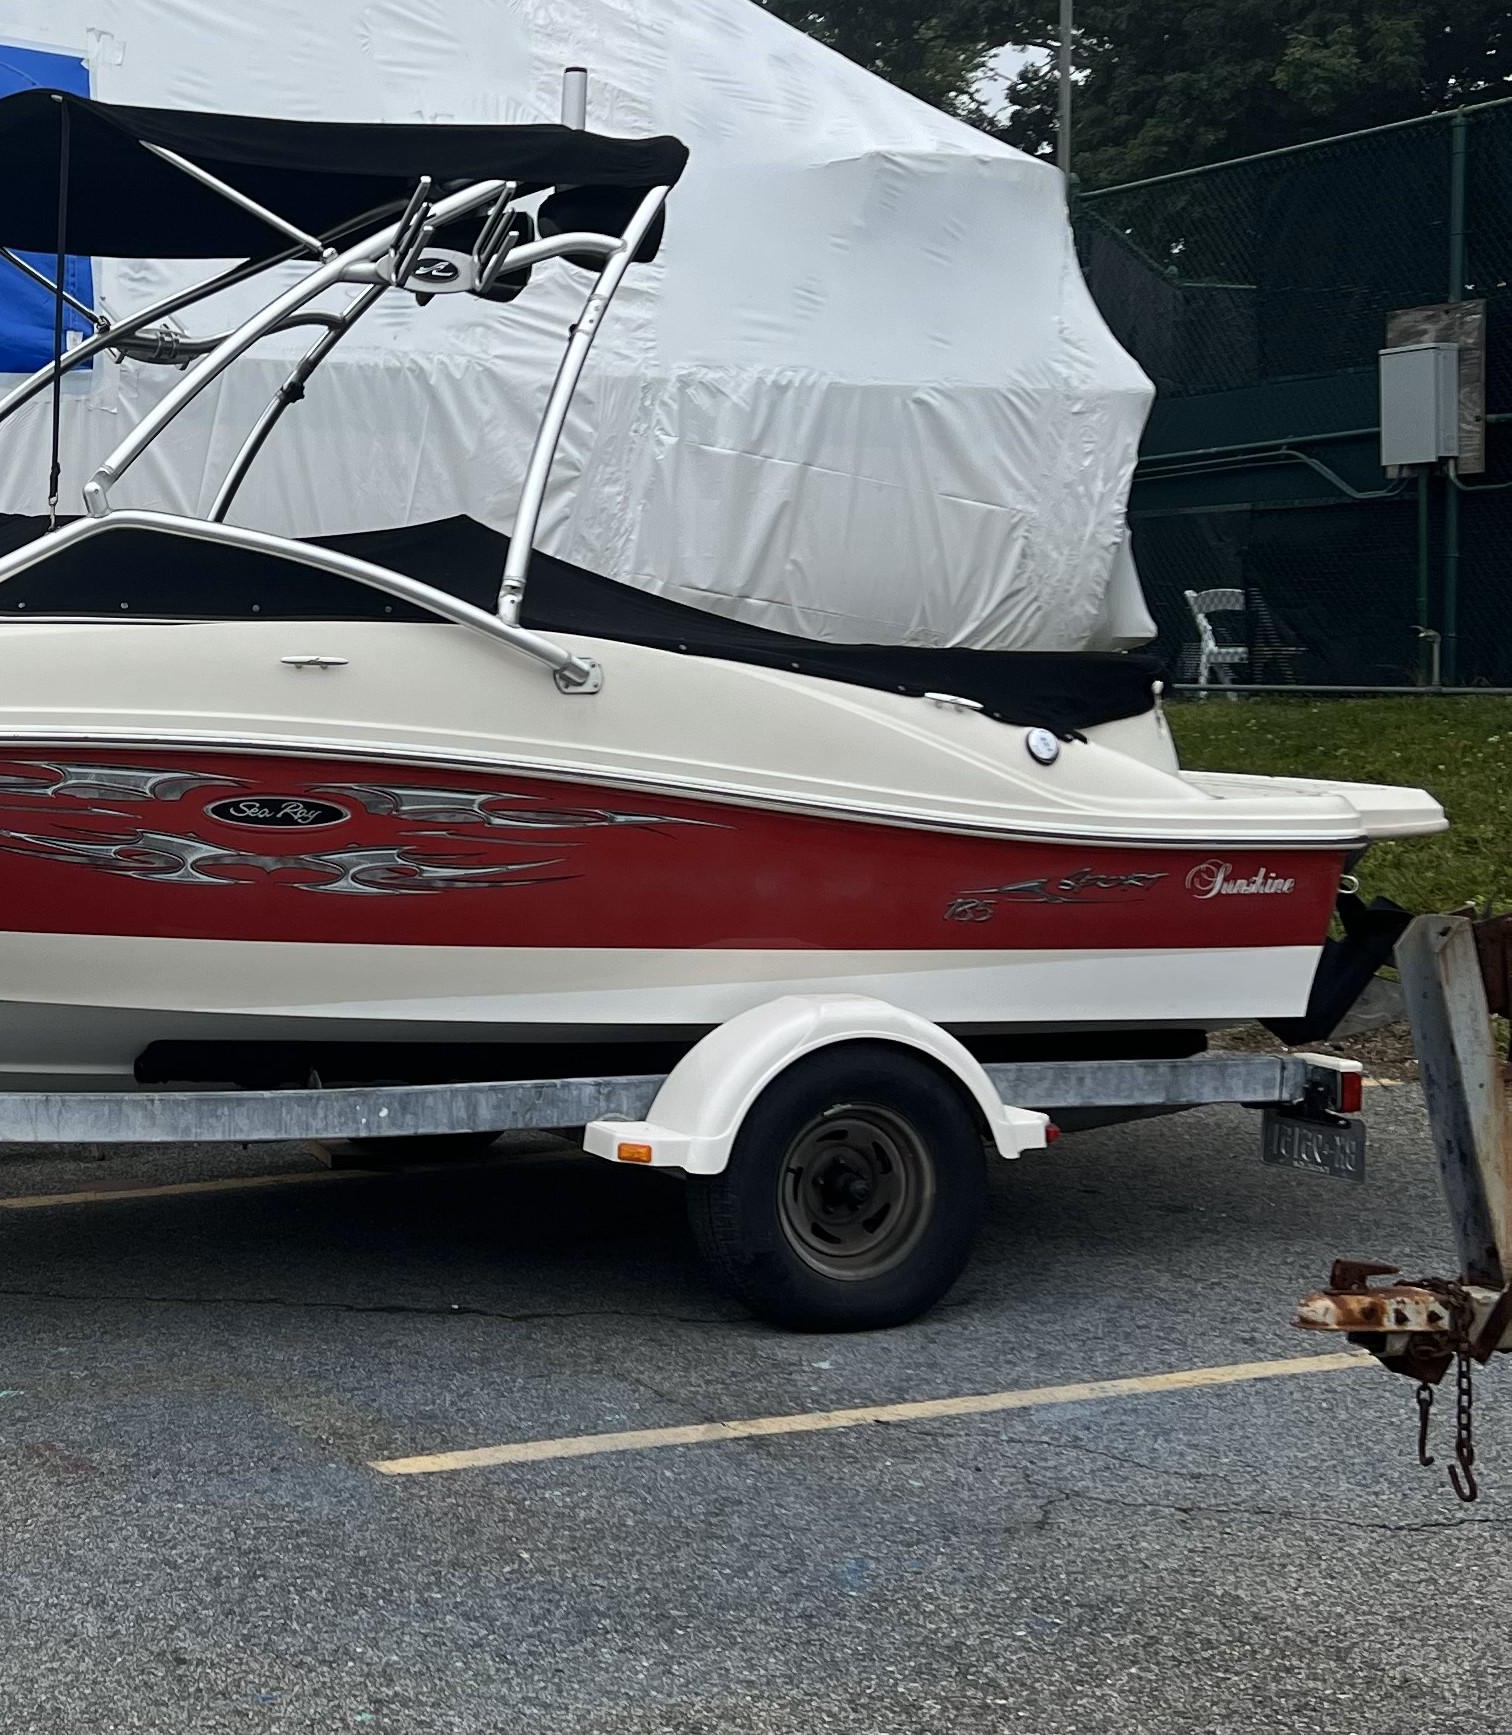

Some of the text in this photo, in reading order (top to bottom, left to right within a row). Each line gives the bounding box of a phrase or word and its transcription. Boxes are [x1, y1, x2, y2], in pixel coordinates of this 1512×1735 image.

[229, 801, 322, 824] Sea Ray
[1185, 858, 1295, 899] Sunshine
